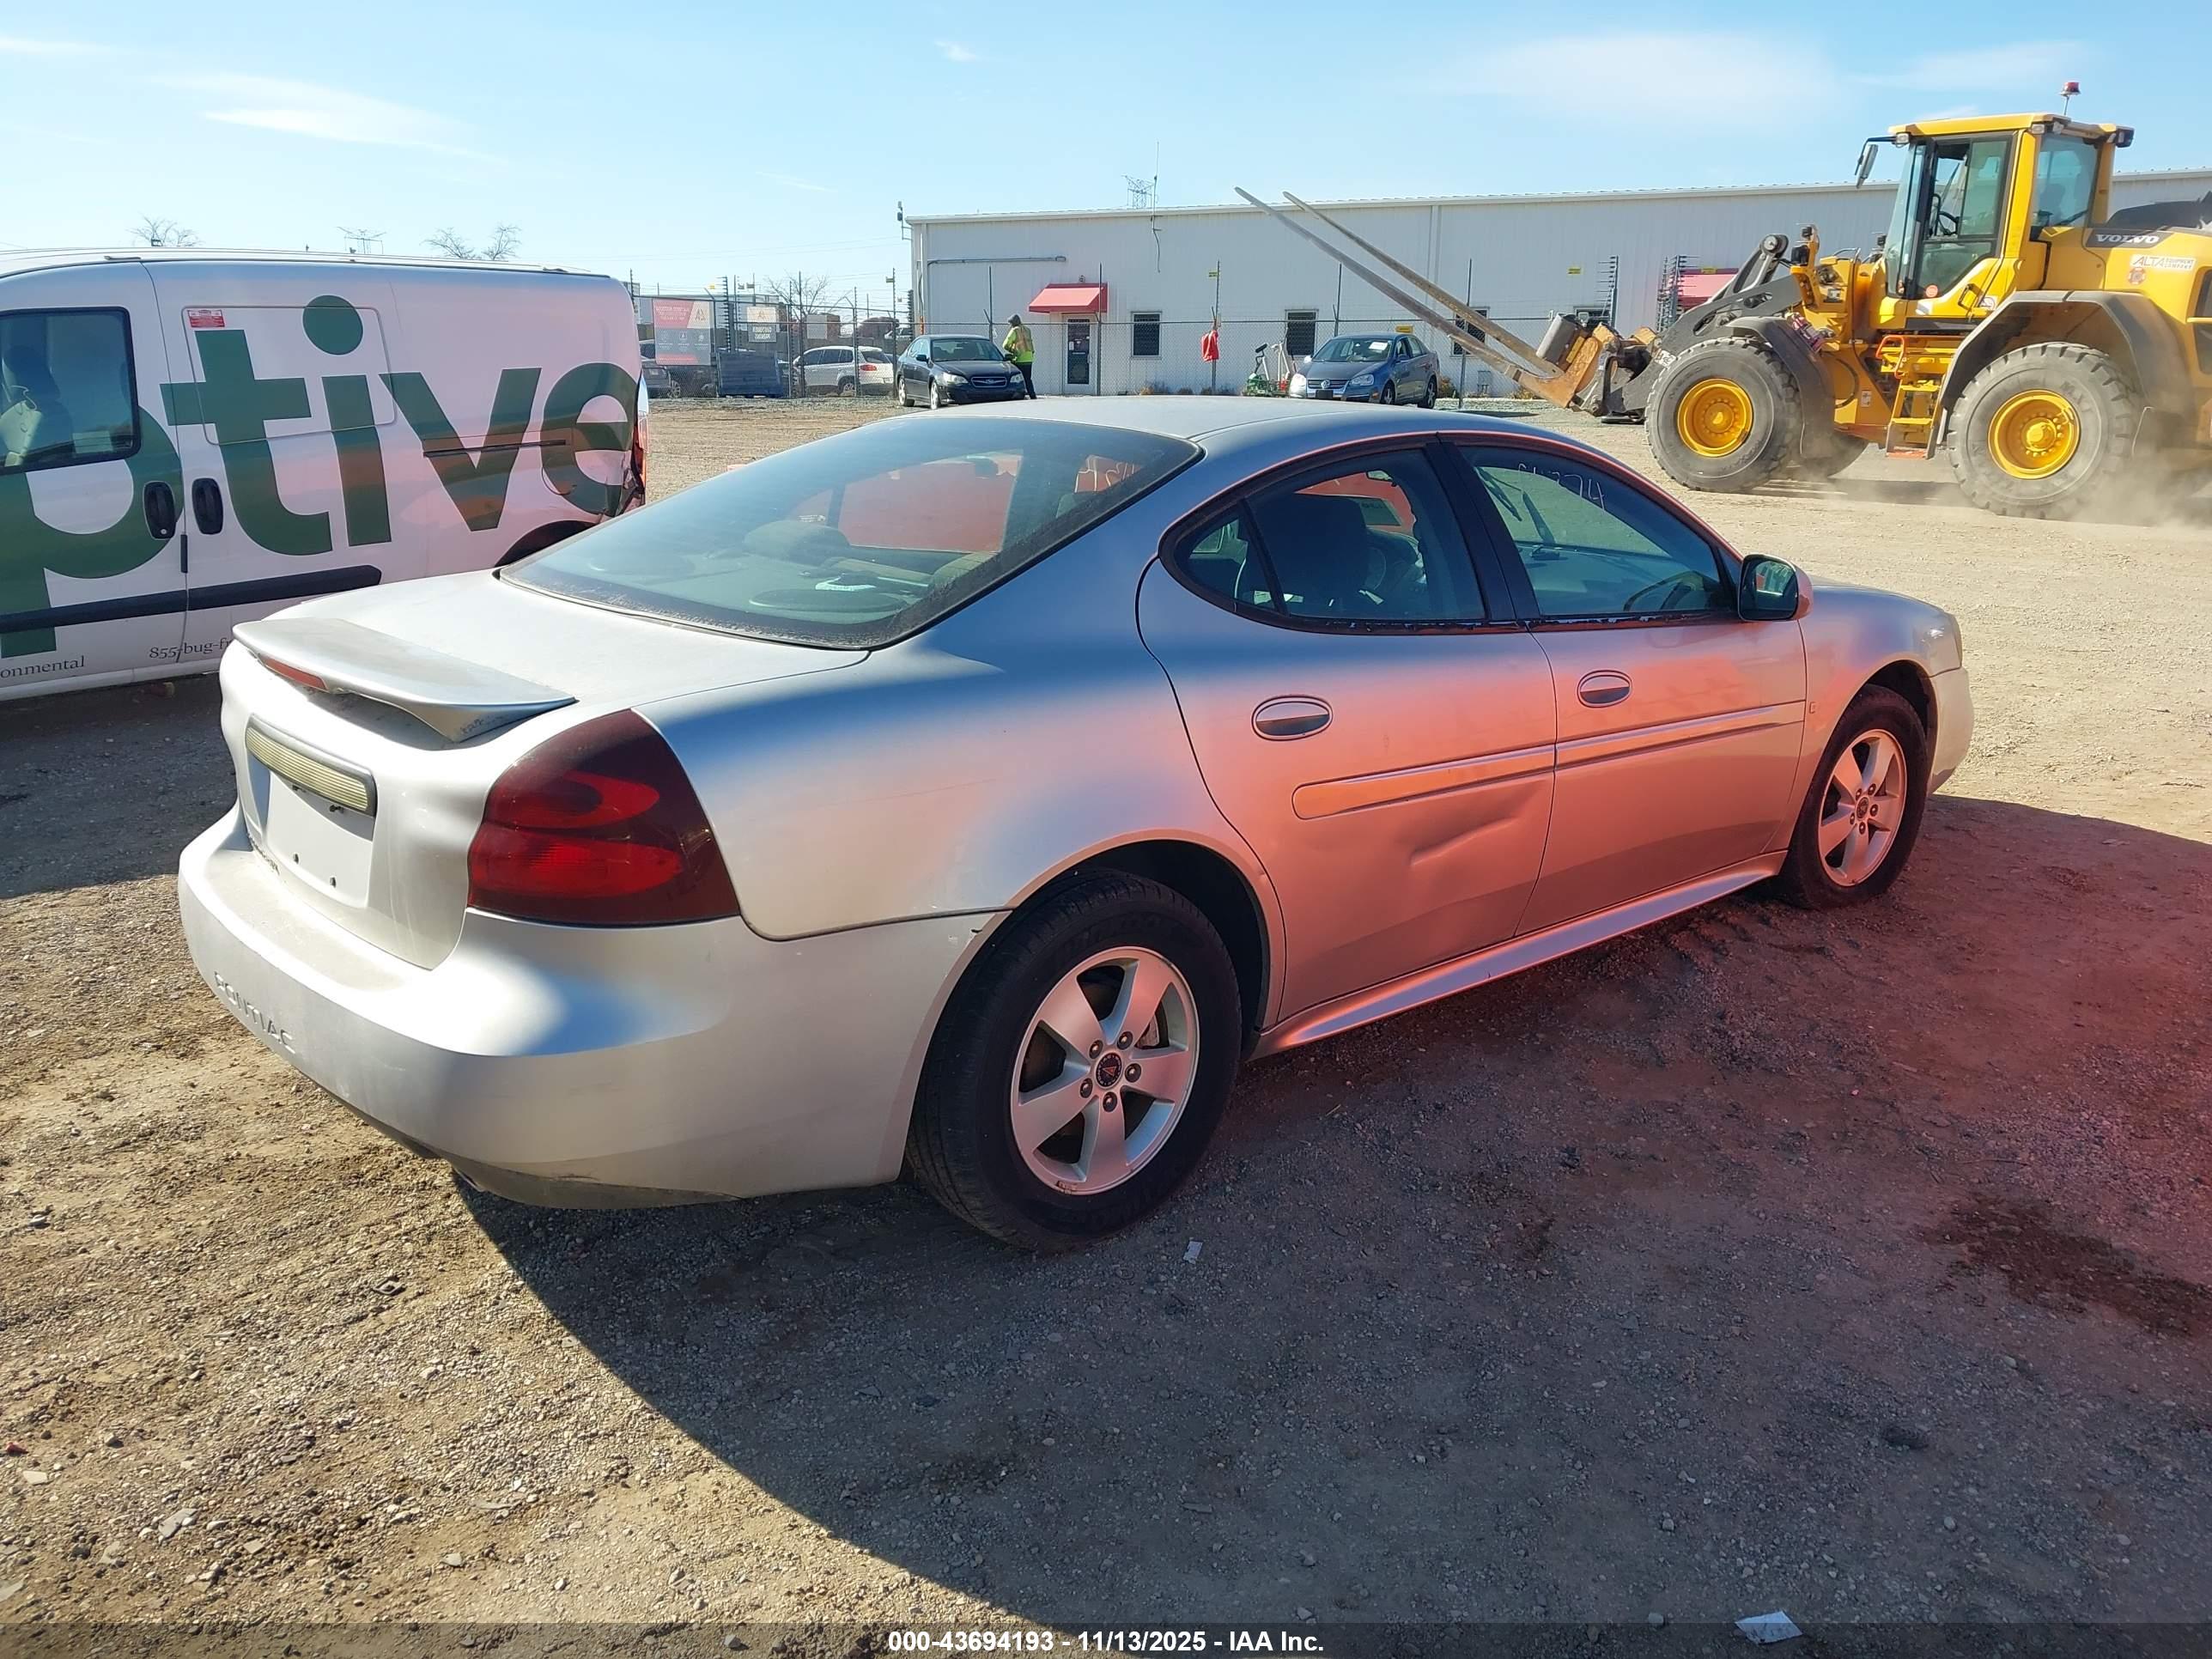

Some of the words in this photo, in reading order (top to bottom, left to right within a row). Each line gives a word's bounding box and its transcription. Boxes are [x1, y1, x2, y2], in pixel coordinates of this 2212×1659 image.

[2095, 234, 2160, 244] VOLVO
[2133, 256, 2164, 267] ALTA
[0, 655, 85, 678] onmental
[214, 970, 295, 1054] PONTIAC
